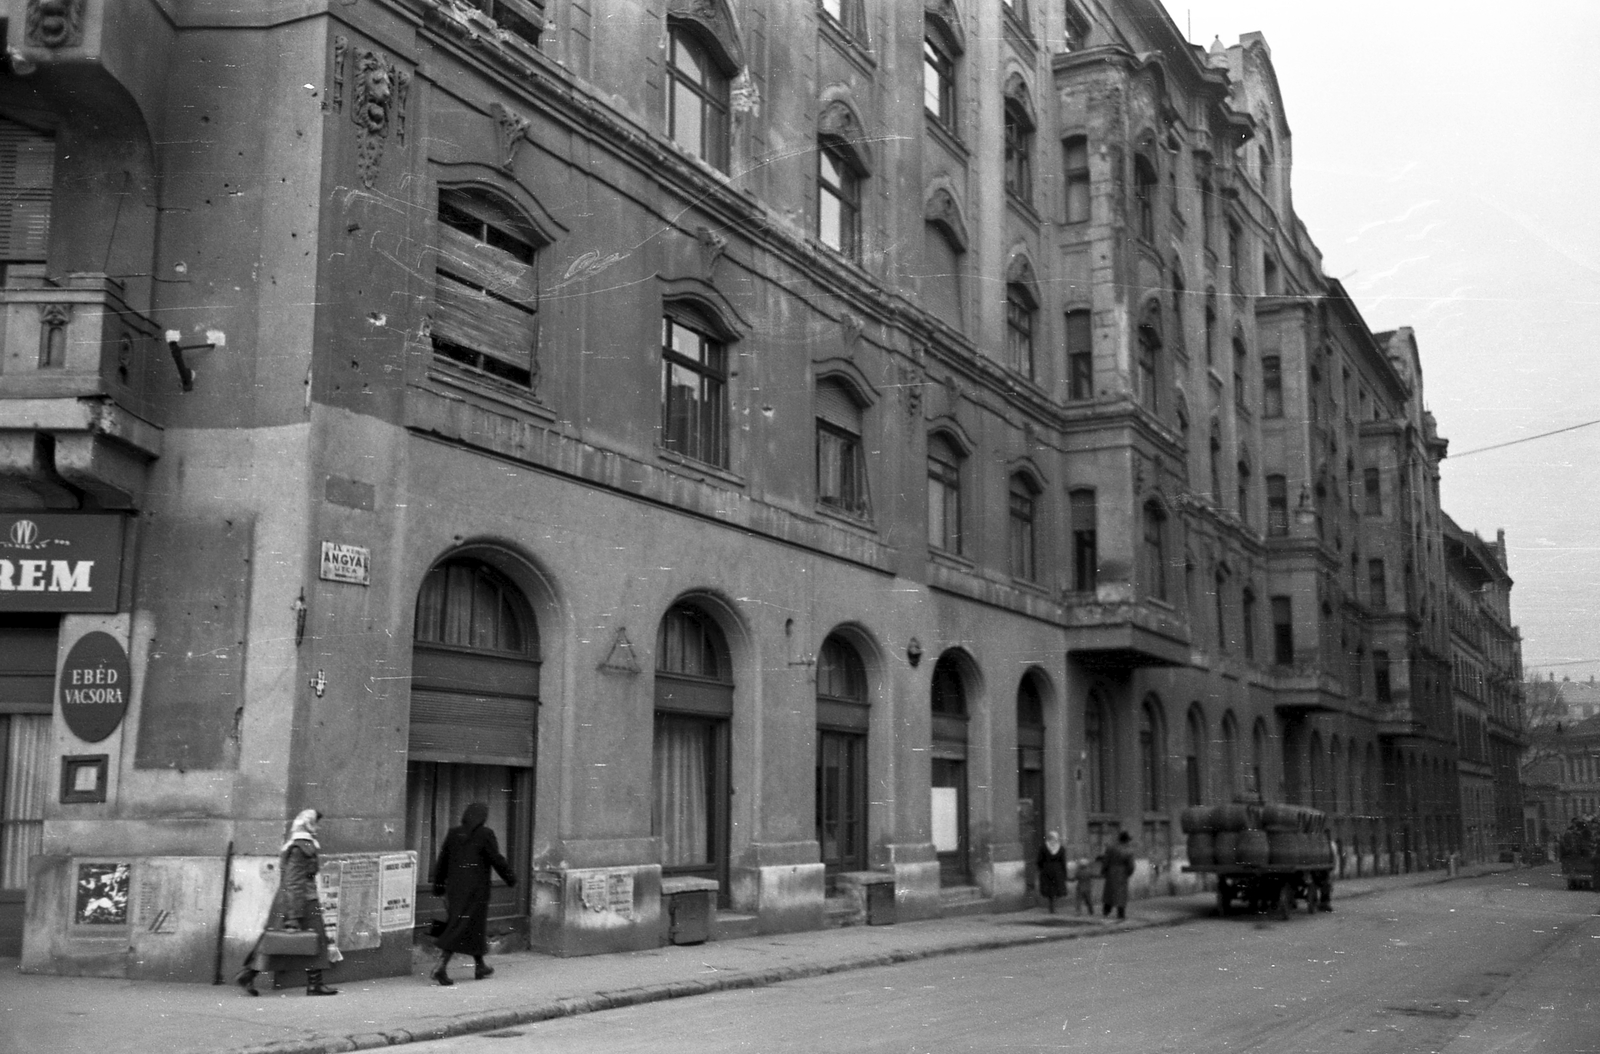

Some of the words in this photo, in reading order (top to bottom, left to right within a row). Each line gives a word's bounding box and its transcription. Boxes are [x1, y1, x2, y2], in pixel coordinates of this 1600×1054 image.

[334, 565, 357, 574] UTCA
[72, 664, 118, 685] EBÉD
[65, 688, 122, 704] VACSORA
